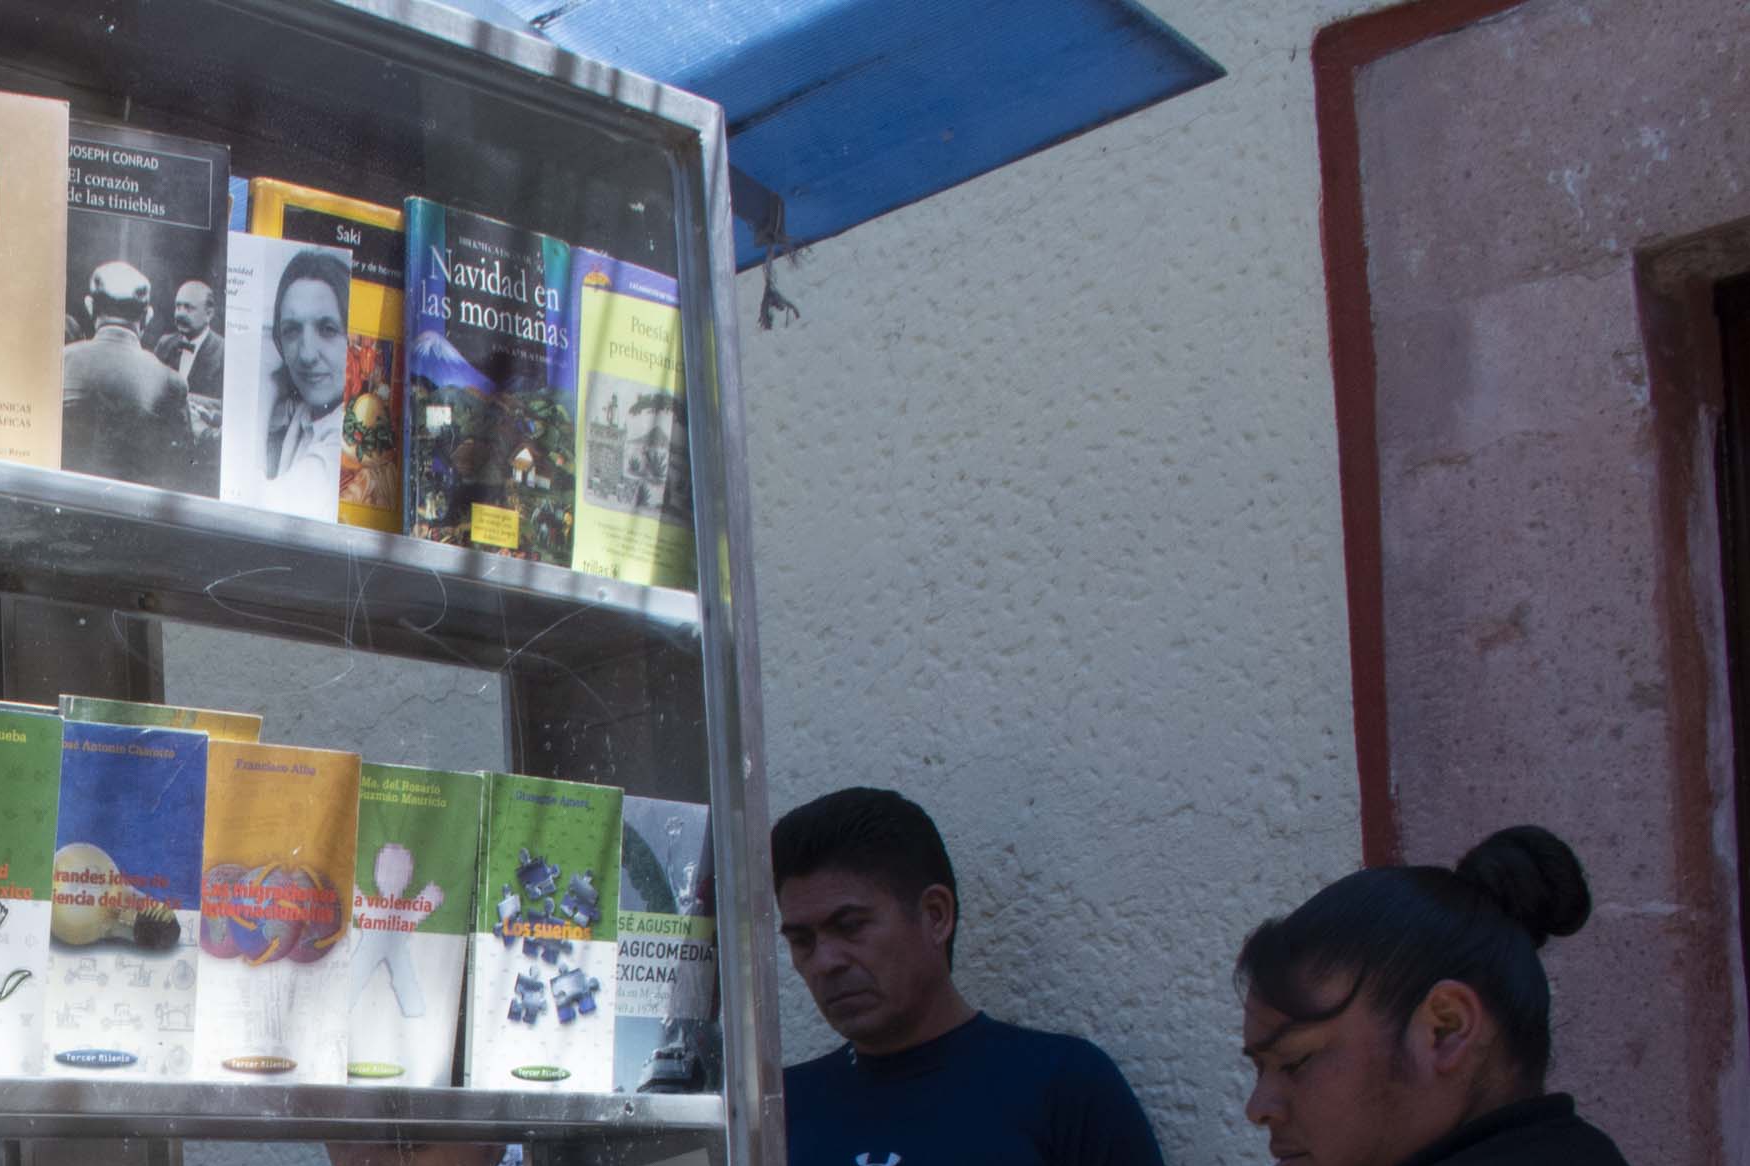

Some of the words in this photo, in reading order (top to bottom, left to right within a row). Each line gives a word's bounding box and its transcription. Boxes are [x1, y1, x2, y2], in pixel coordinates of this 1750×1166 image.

[69, 145, 110, 162] JOSEPH
[113, 151, 159, 170] CONRAD
[68, 167, 80, 183] El
[84, 174, 139, 193] corazón
[67, 187, 83, 202] de
[87, 188, 105, 205] las
[109, 193, 166, 217] tinieblas
[336, 225, 362, 245] Saki
[430, 245, 527, 303] Navidad
[534, 283, 560, 312] en
[421, 279, 451, 320] las
[460, 301, 569, 350] montañas
[631, 315, 674, 346] Poesía
[235, 759, 287, 774] Francisco
[382, 778, 399, 791] del
[402, 780, 441, 794] Rosario
[402, 793, 447, 808] Mauricio
[98, 890, 122, 907] del
[367, 893, 433, 913] violencia
[358, 913, 416, 932] familiar
[503, 917, 530, 937] Los
[533, 920, 592, 940] sueños
[637, 917, 692, 935] AGUSTÍN
[619, 940, 713, 962] AGICOMEDIA
[66, 1053, 96, 1063] Tercer
